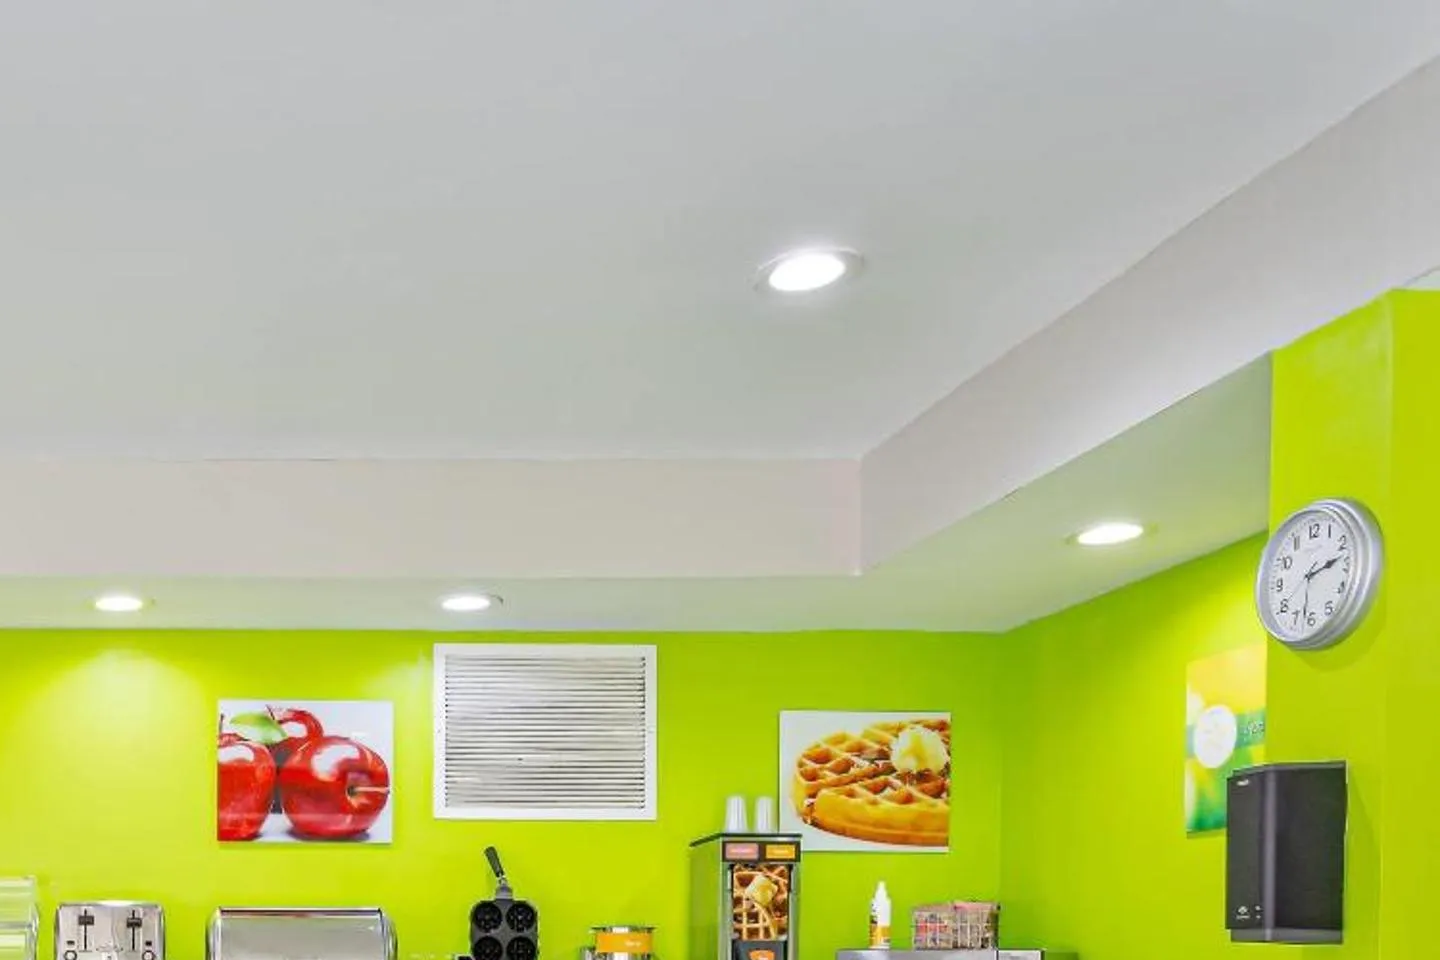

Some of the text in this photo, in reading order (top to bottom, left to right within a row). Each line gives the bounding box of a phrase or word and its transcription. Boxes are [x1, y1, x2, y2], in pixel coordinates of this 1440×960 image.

[1309, 523, 1321, 540] 12
[1328, 523, 1332, 538] 1
[1293, 535, 1301, 551] 11
[1338, 535, 1347, 551] 2
[1282, 556, 1293, 570] 10
[1276, 578, 1284, 592] 9
[1280, 598, 1289, 613] 8
[1324, 601, 1334, 616] 5
[1292, 610, 1301, 625] 7
[1307, 612, 1317, 627] 6
